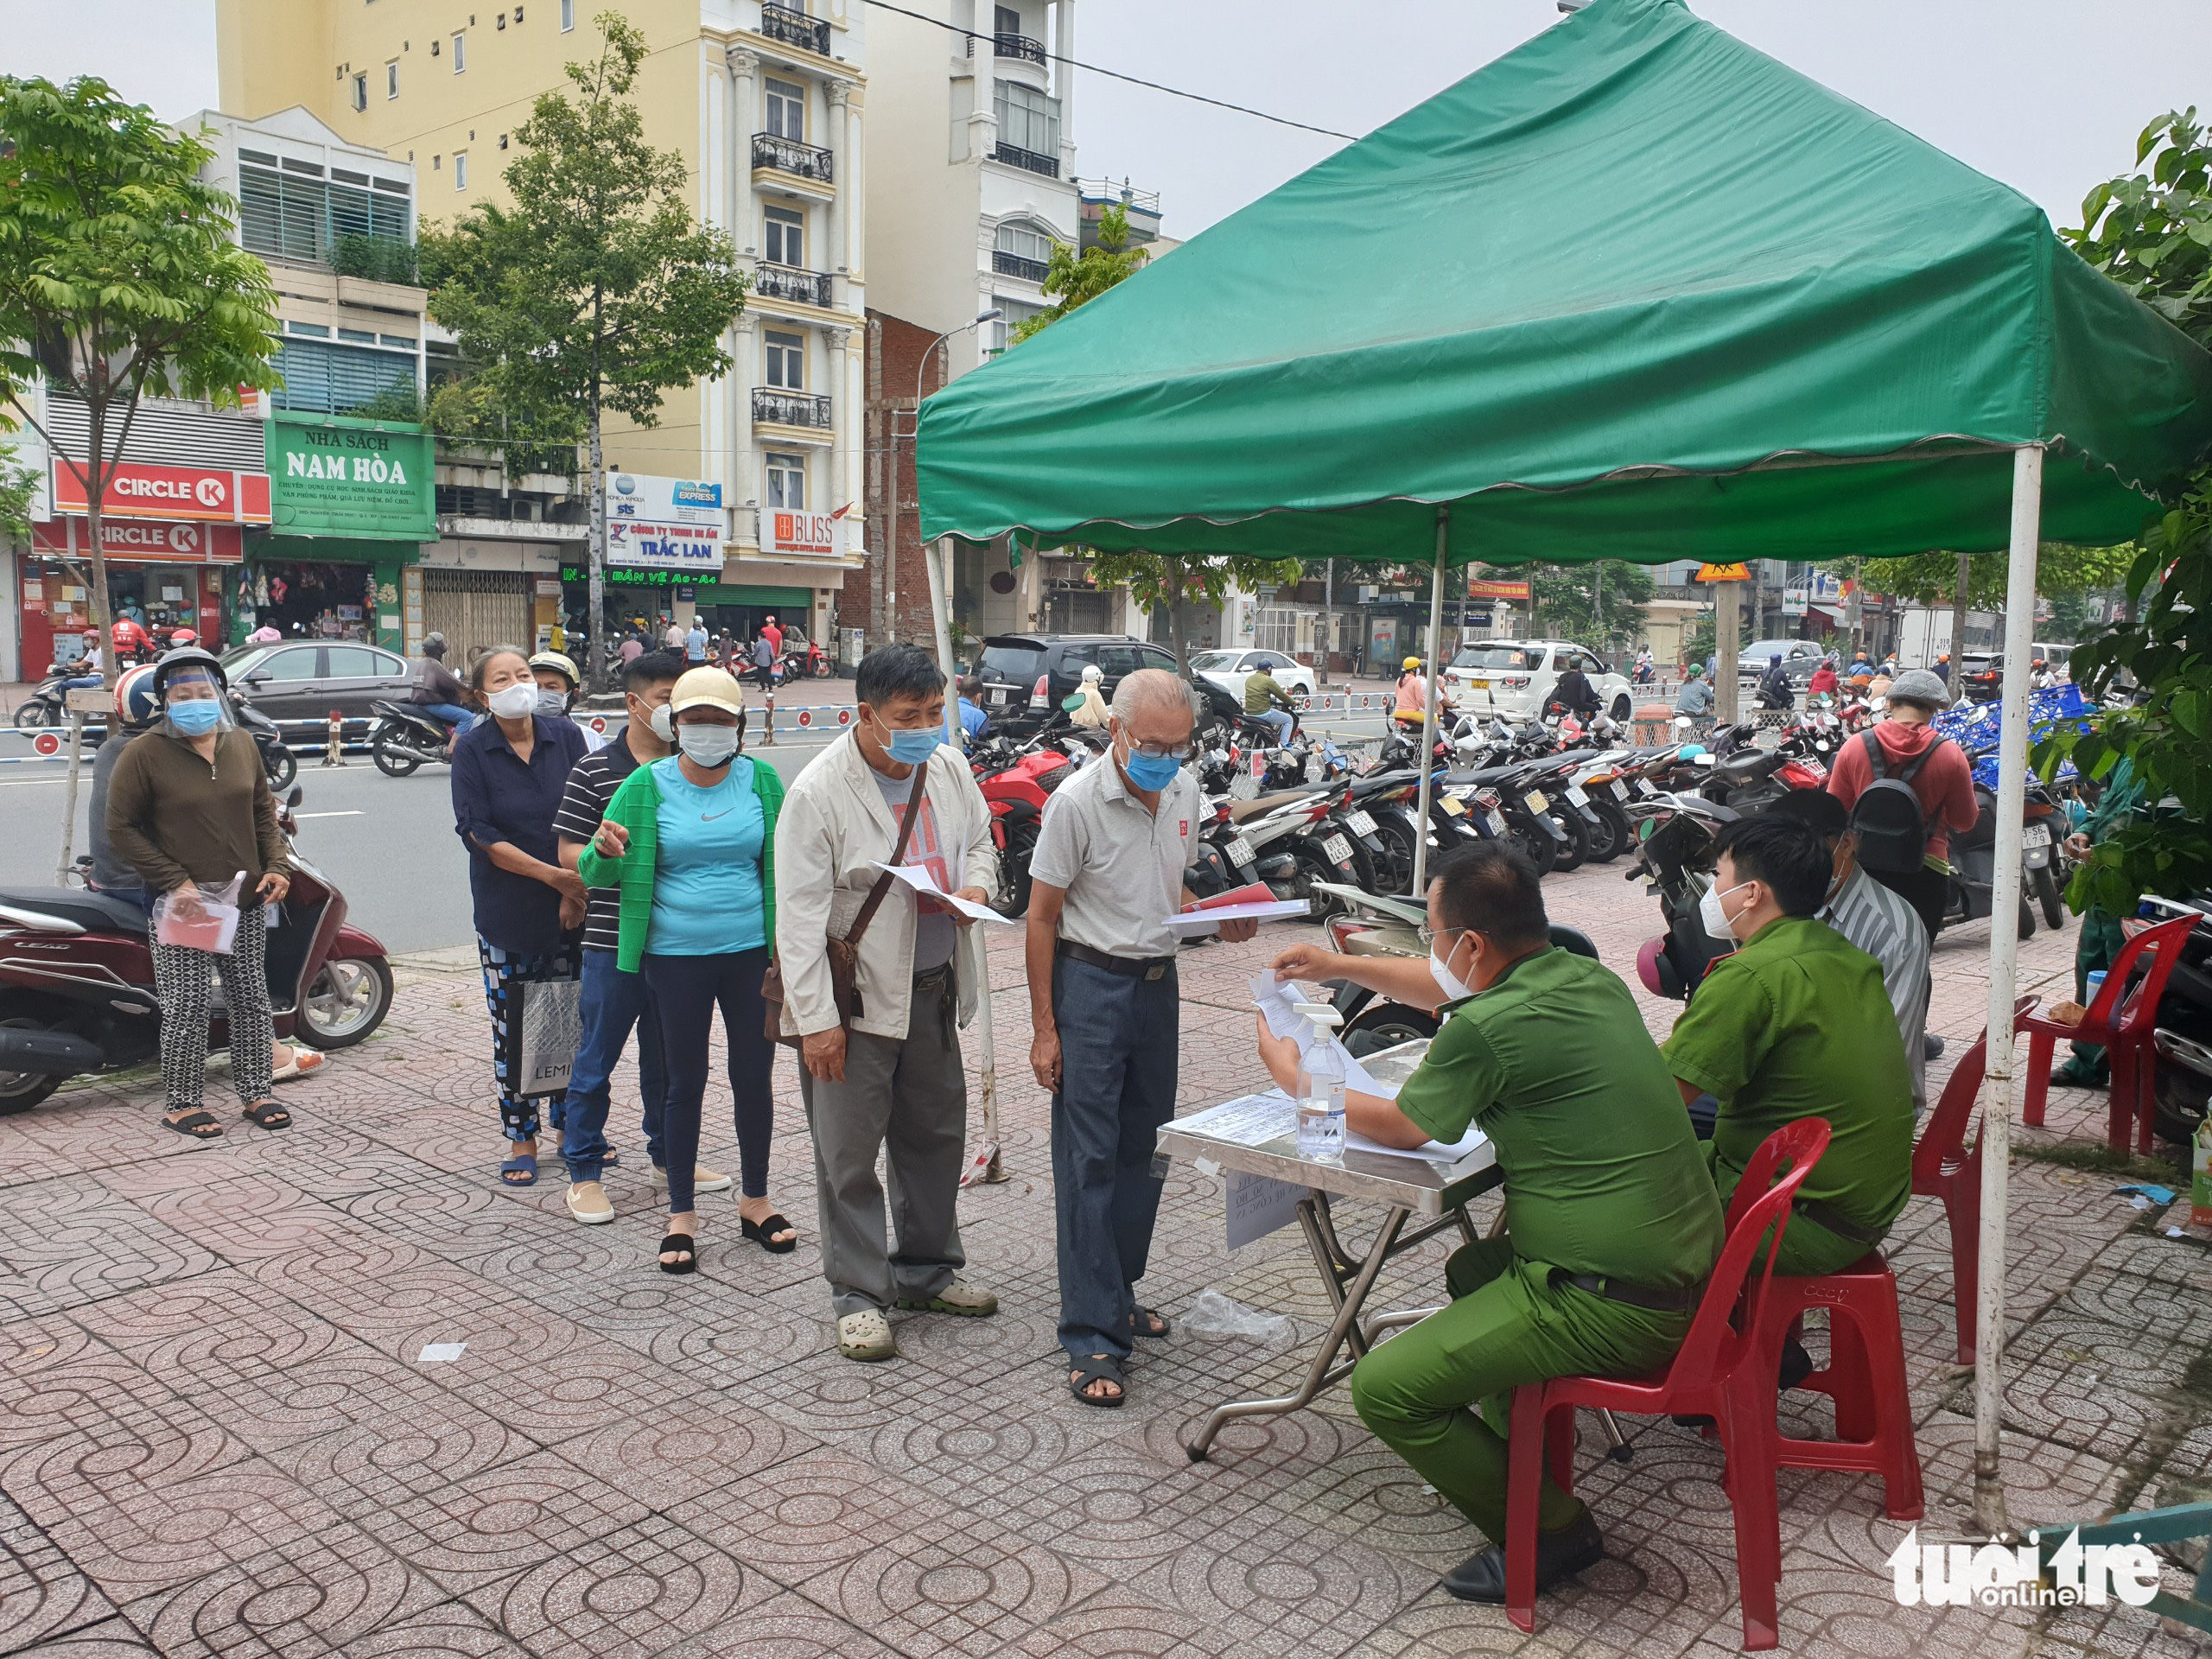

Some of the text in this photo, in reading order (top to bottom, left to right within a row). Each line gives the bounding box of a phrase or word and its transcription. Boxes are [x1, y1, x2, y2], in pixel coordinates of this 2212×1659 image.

[305, 431, 389, 451] NHÀ SÁCH
[286, 451, 407, 484] NAM HÒA
[114, 477, 225, 506] CIRCLE K
[678, 492, 715, 502] EXPRESS
[170, 527, 197, 551] K
[630, 524, 655, 536] CÔNG
[657, 527, 668, 537] TY
[796, 515, 832, 543] BLISS
[640, 536, 712, 559] TRẮC LAN
[563, 569, 577, 581] IN
[1229, 840, 1249, 855] 59-F1
